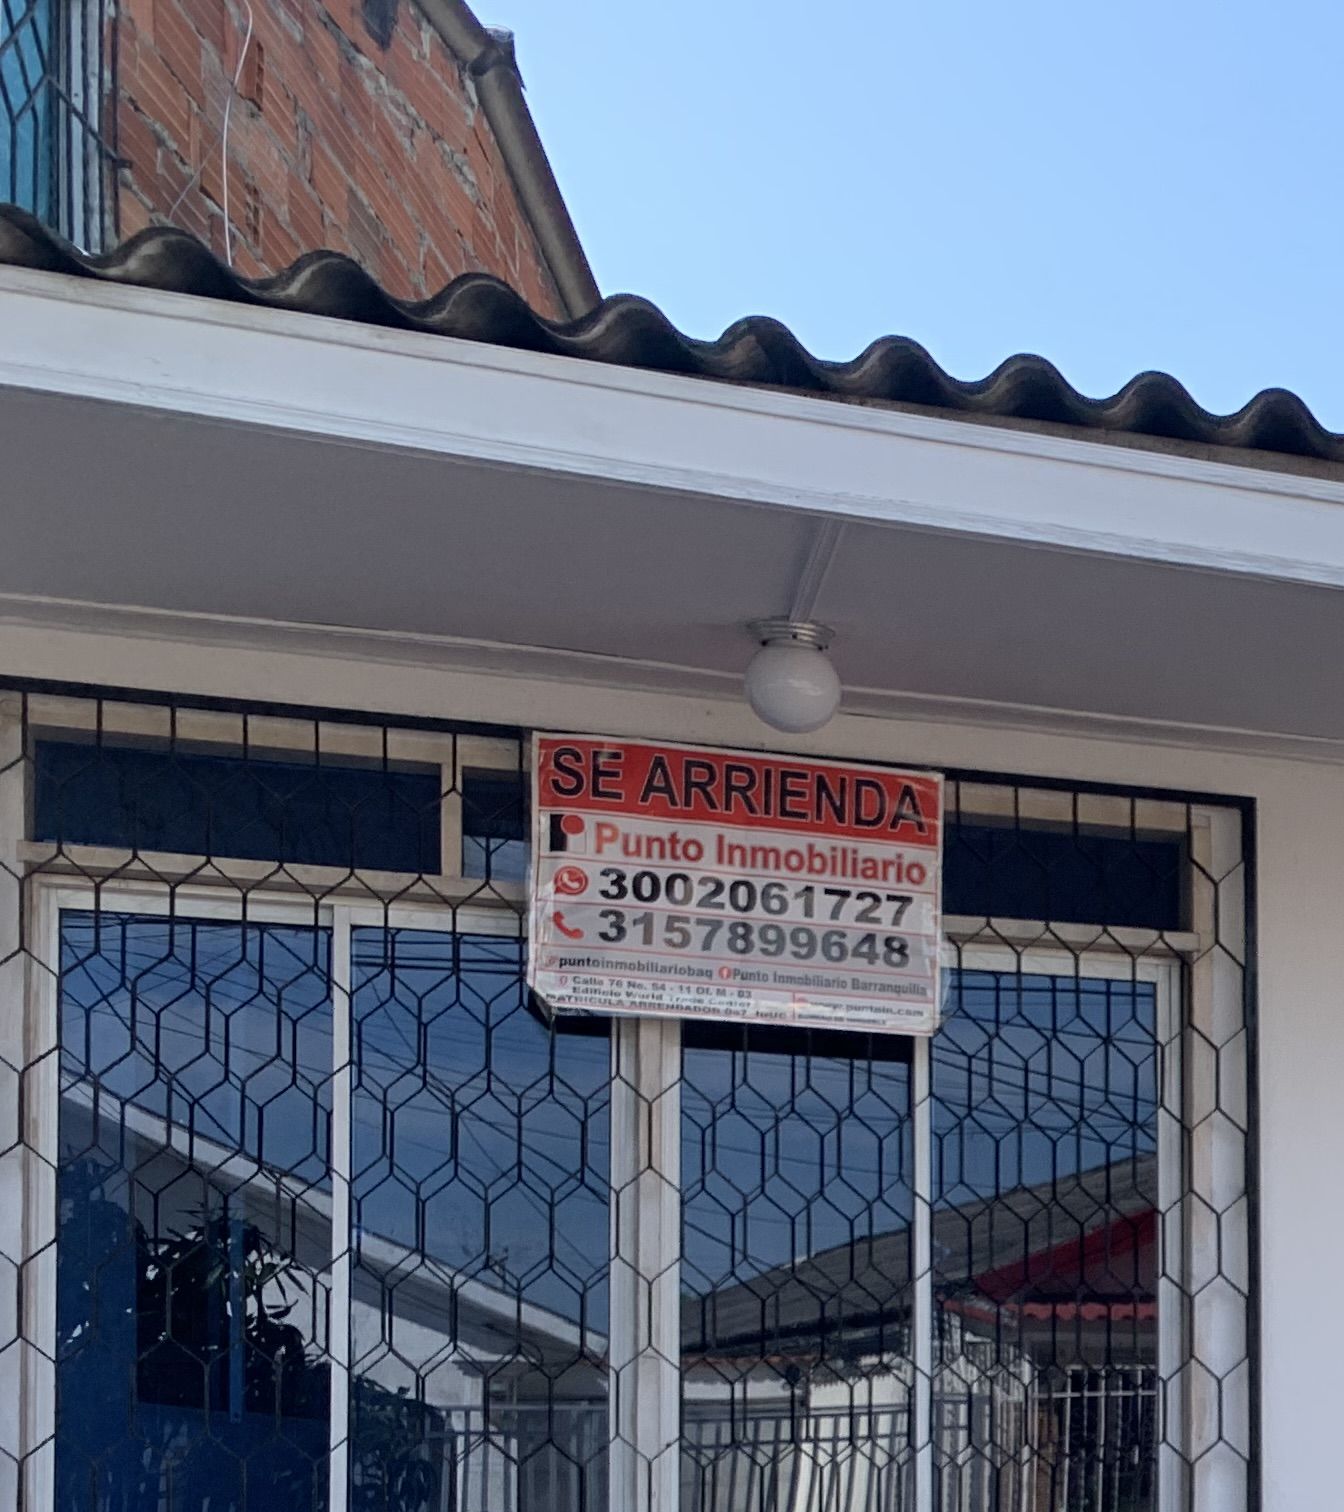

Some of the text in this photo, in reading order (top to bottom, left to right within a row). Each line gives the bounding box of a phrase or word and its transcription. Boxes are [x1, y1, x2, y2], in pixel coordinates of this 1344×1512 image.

[550, 747, 928, 833] SE ARRIENDA
[594, 822, 927, 886] Punto Inmobiliario
[599, 867, 914, 926] 3002061727
[559, 956, 713, 979] puntoinmobiliariobaq
[598, 908, 909, 968] 3157899648
[733, 968, 928, 997] Punto Inmobiliario Barranquilla
